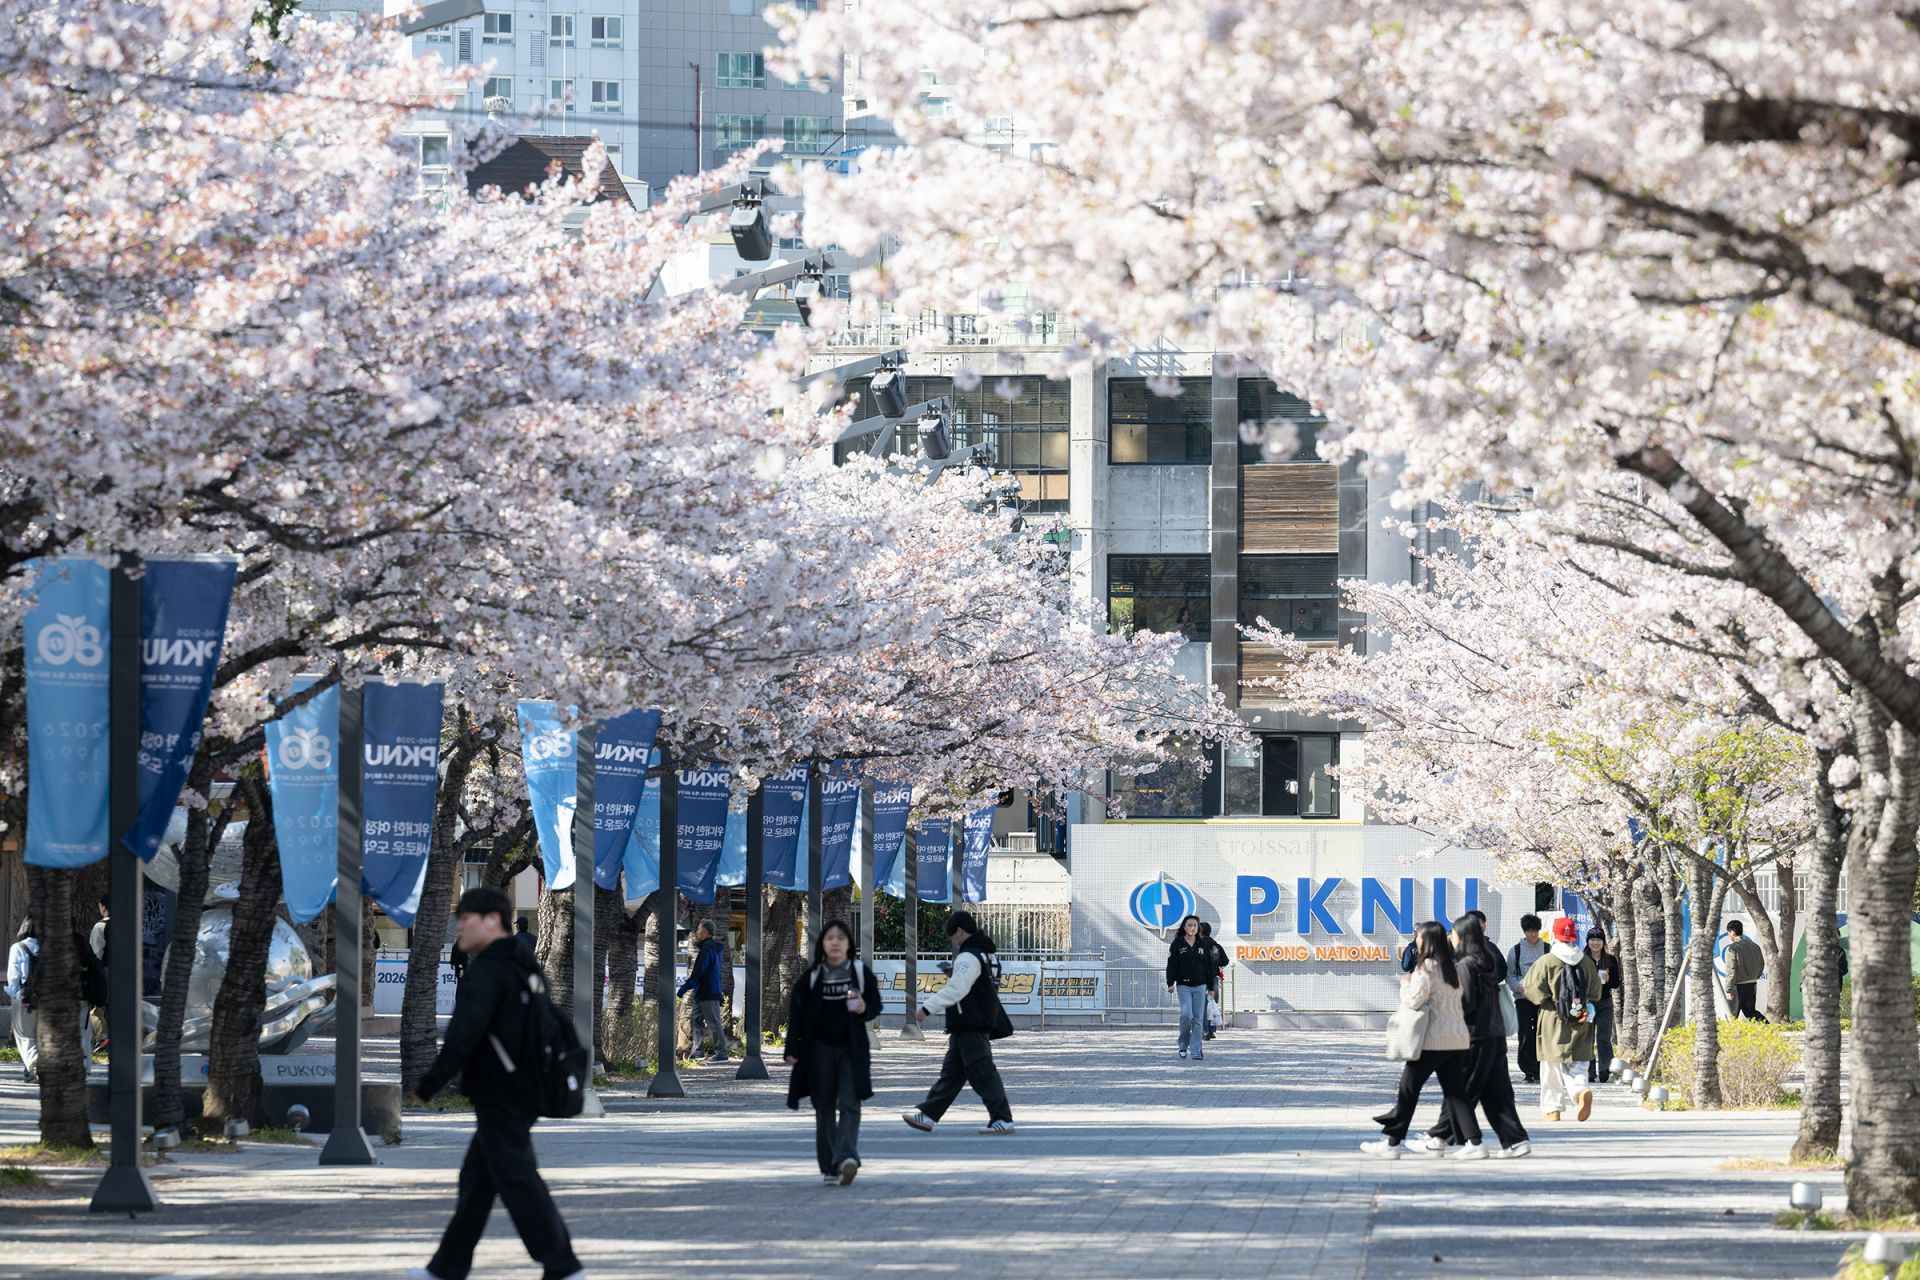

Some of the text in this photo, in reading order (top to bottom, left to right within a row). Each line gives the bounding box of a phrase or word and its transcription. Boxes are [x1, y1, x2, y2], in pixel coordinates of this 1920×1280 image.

[1236, 875, 1479, 936] PKNU
[1236, 945, 1309, 962] PUKYONG
[1315, 945, 1390, 962] NATIONAL
[377, 972, 407, 984] 2026
